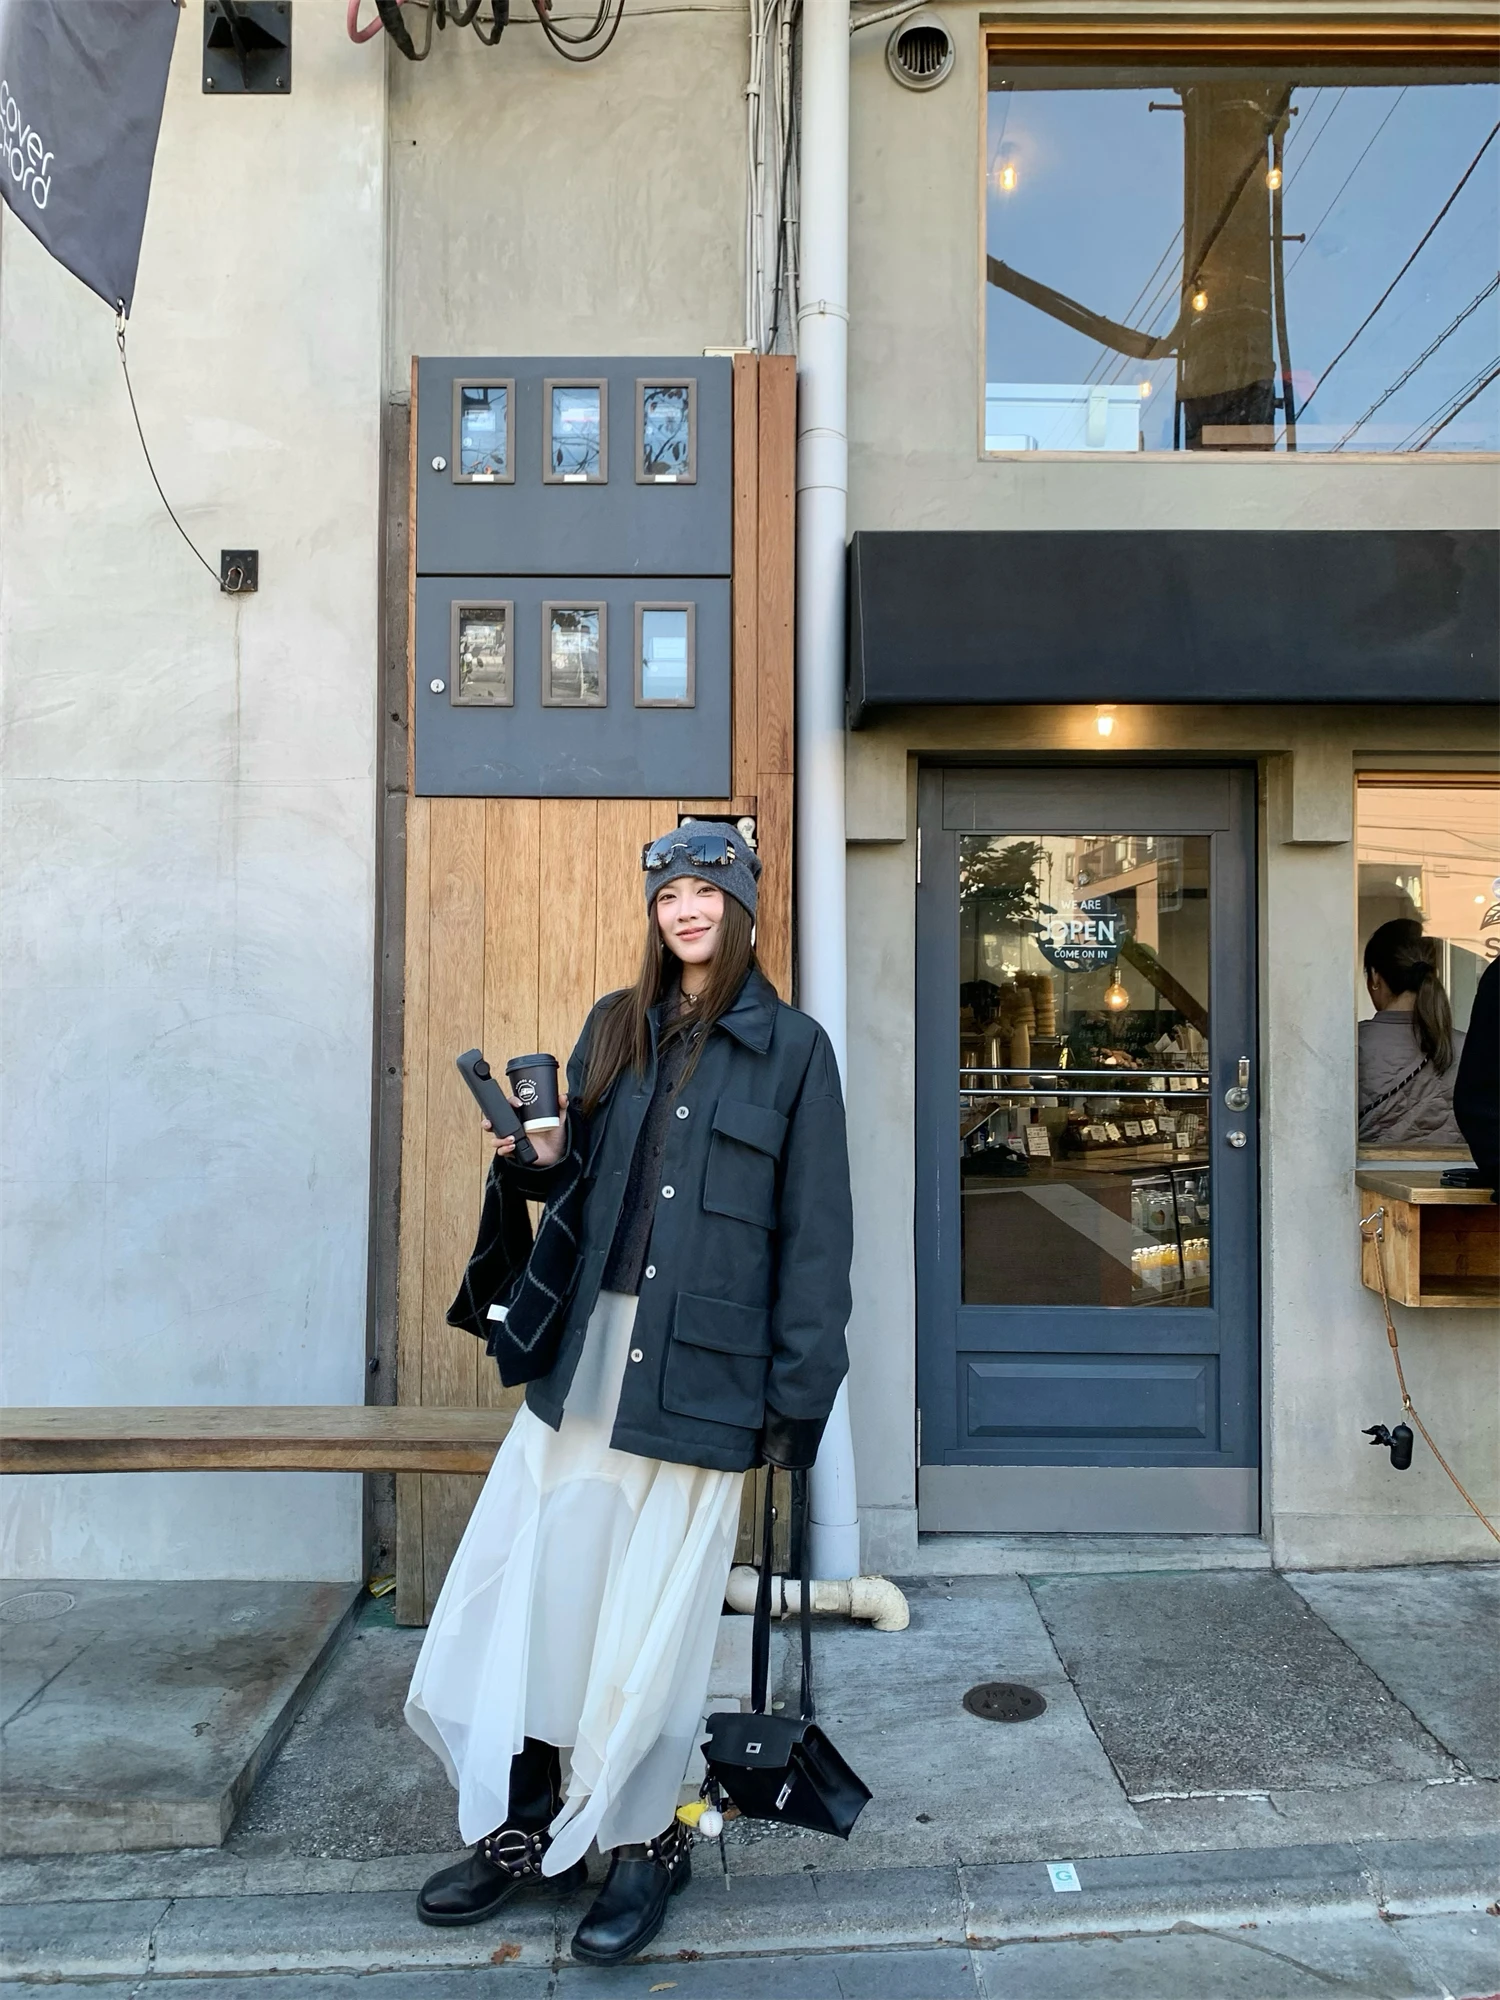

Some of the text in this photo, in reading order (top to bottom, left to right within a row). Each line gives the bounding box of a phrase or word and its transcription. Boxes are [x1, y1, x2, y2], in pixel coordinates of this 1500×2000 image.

[1061, 900, 1101, 910] WE ARE
[1050, 920, 1115, 941] OPEN
[1054, 950, 1108, 959] COME ON IN
[1055, 1870, 1073, 1881] G
